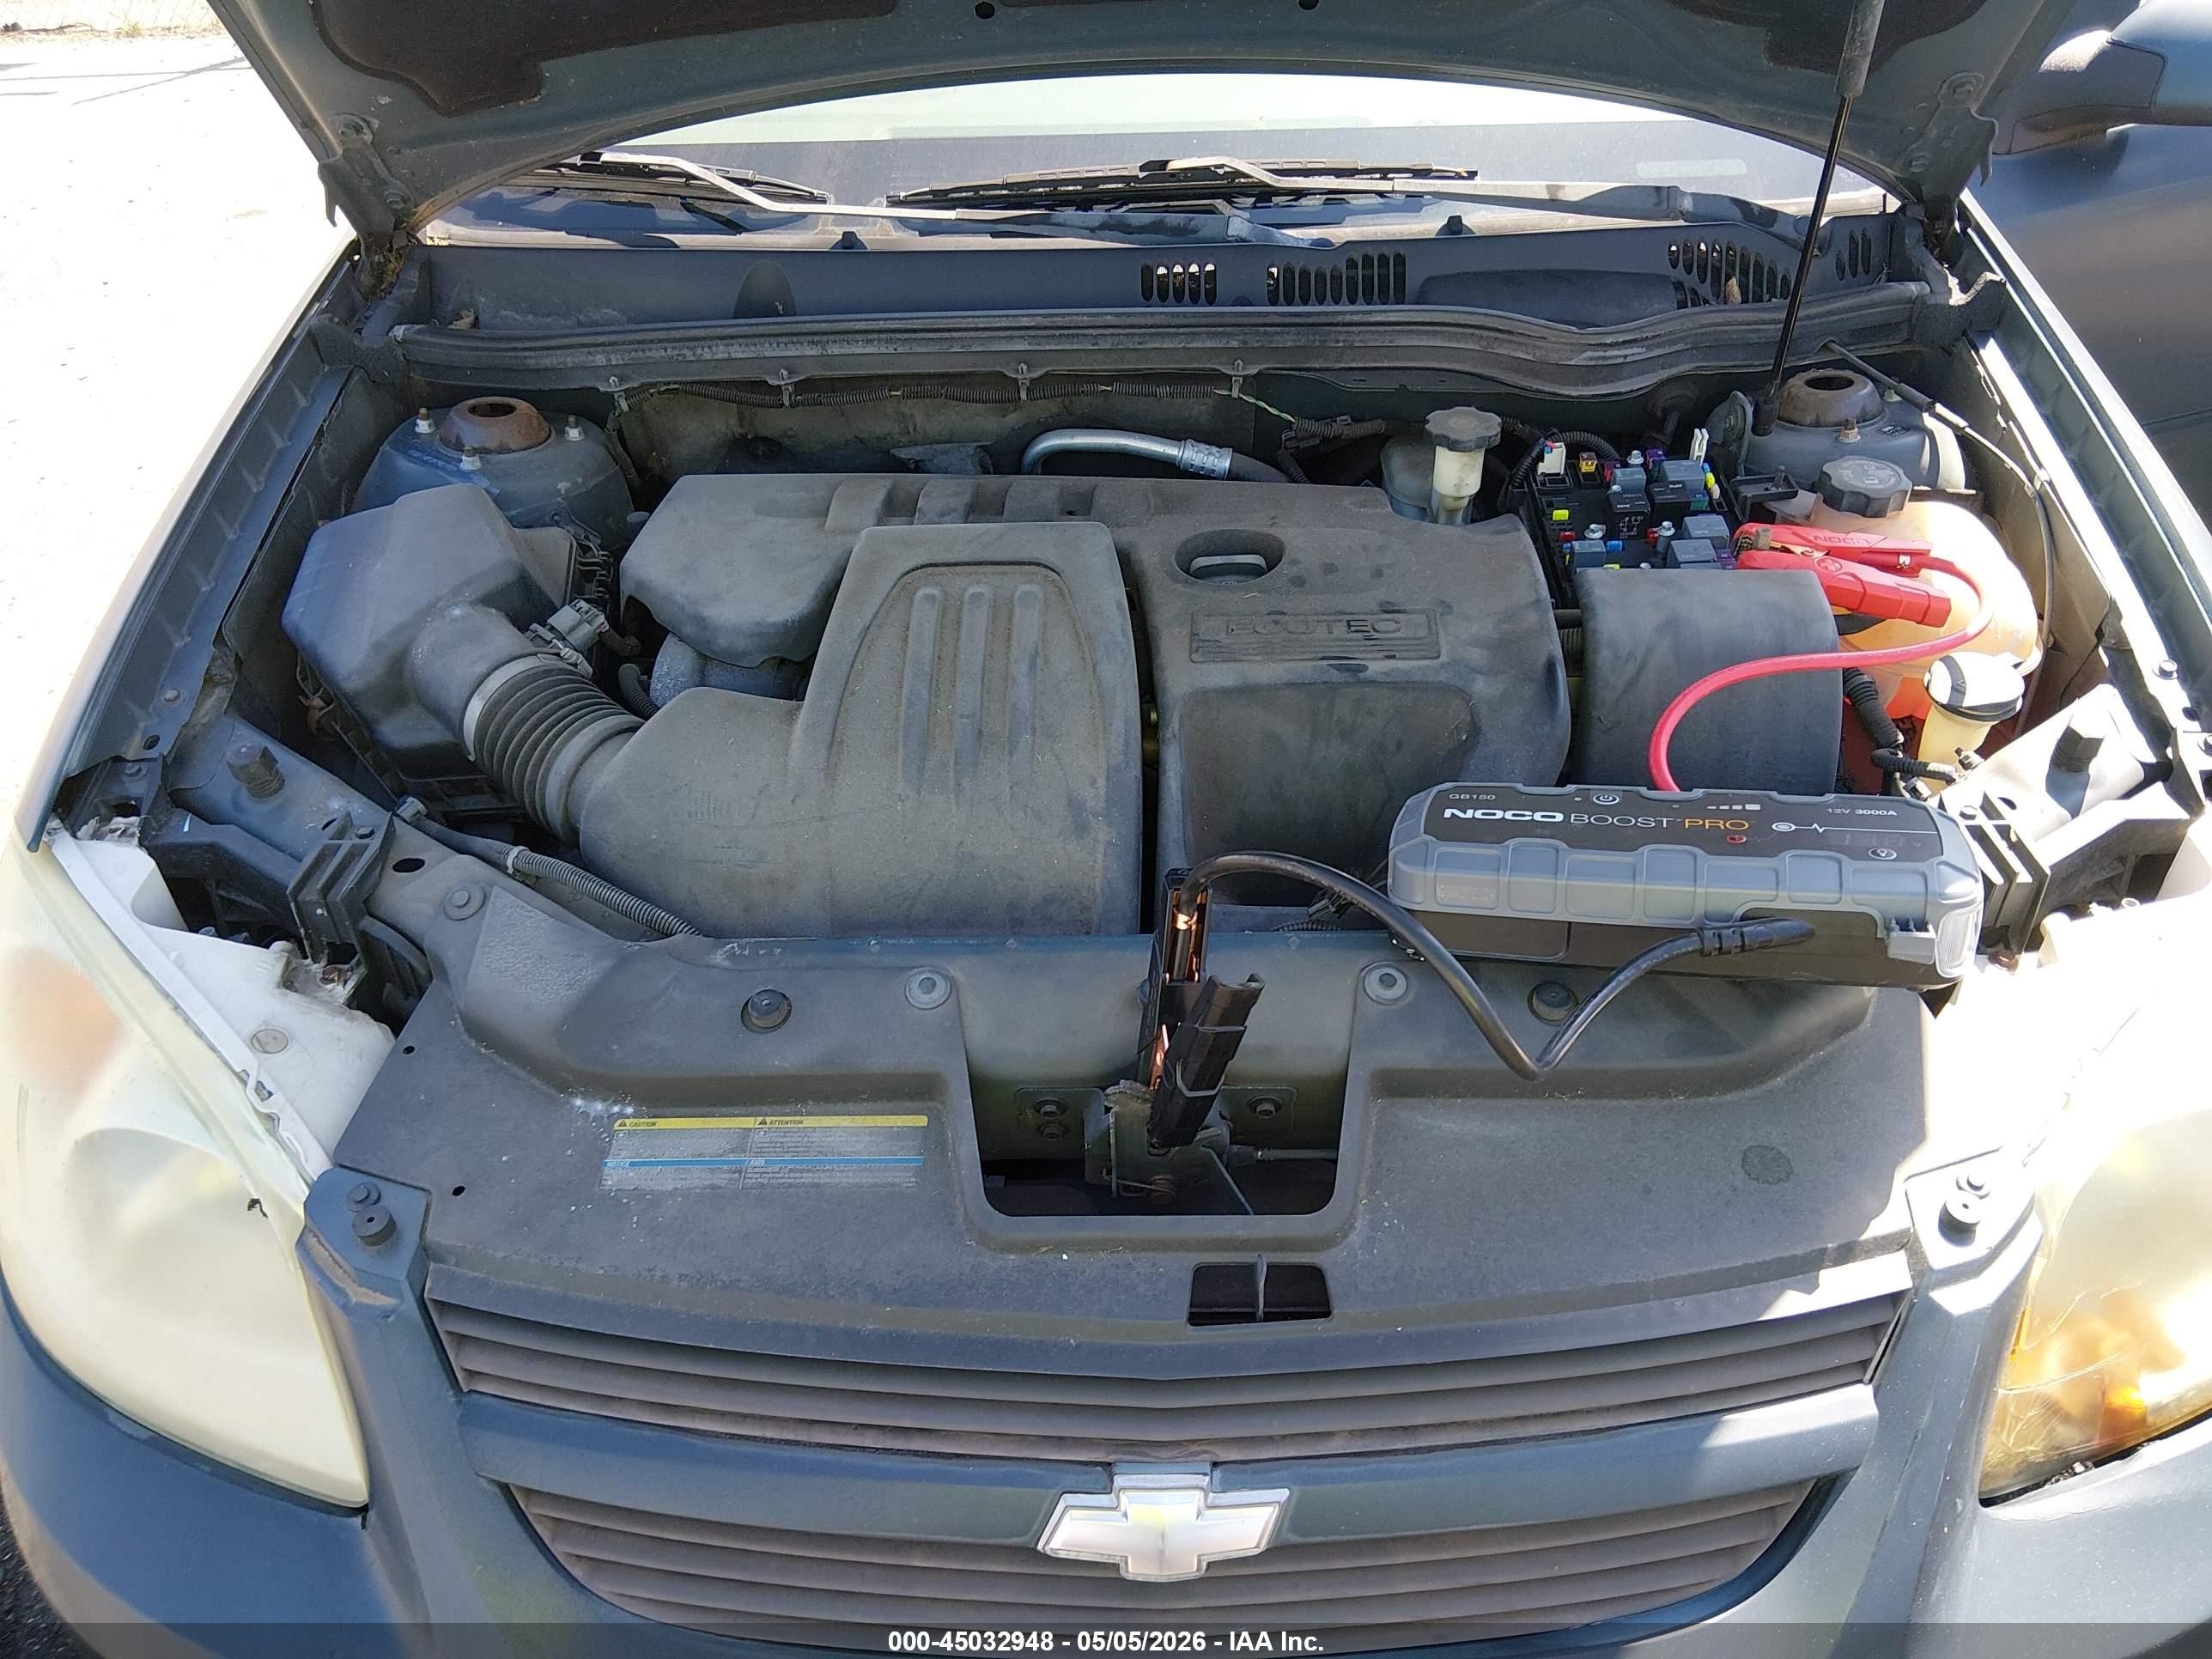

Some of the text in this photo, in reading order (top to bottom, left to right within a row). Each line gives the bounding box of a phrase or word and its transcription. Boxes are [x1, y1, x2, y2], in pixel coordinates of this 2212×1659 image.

[1812, 534, 1871, 546] NOCO
[1855, 808, 1898, 817] 3000A
[1443, 808, 1749, 830] NOCO BOOST PRO
